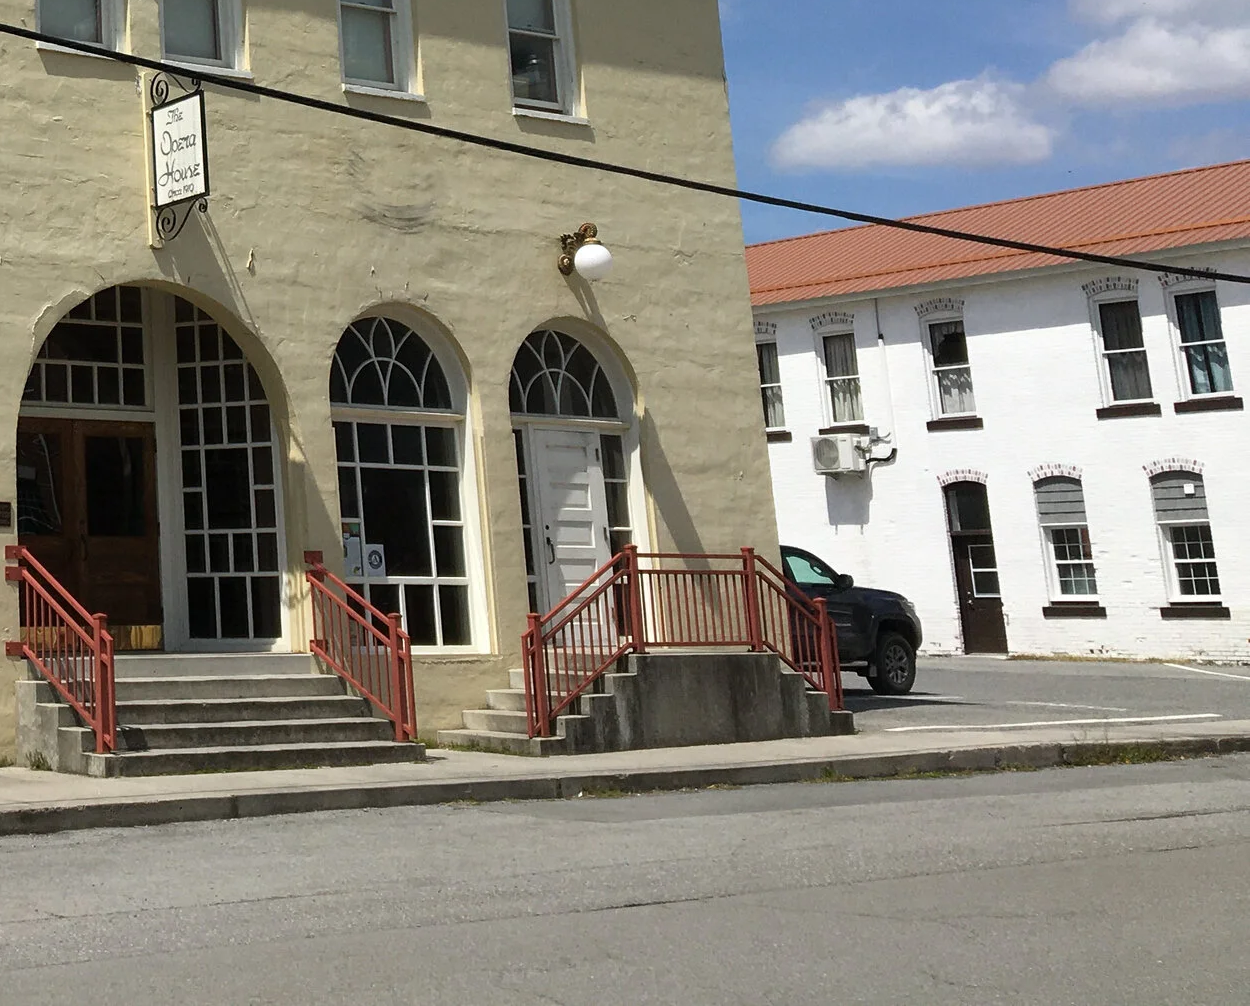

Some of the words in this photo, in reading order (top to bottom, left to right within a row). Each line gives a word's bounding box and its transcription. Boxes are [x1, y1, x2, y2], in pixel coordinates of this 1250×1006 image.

[166, 108, 183, 125] The
[161, 130, 196, 157] Opera
[158, 158, 200, 186] House
